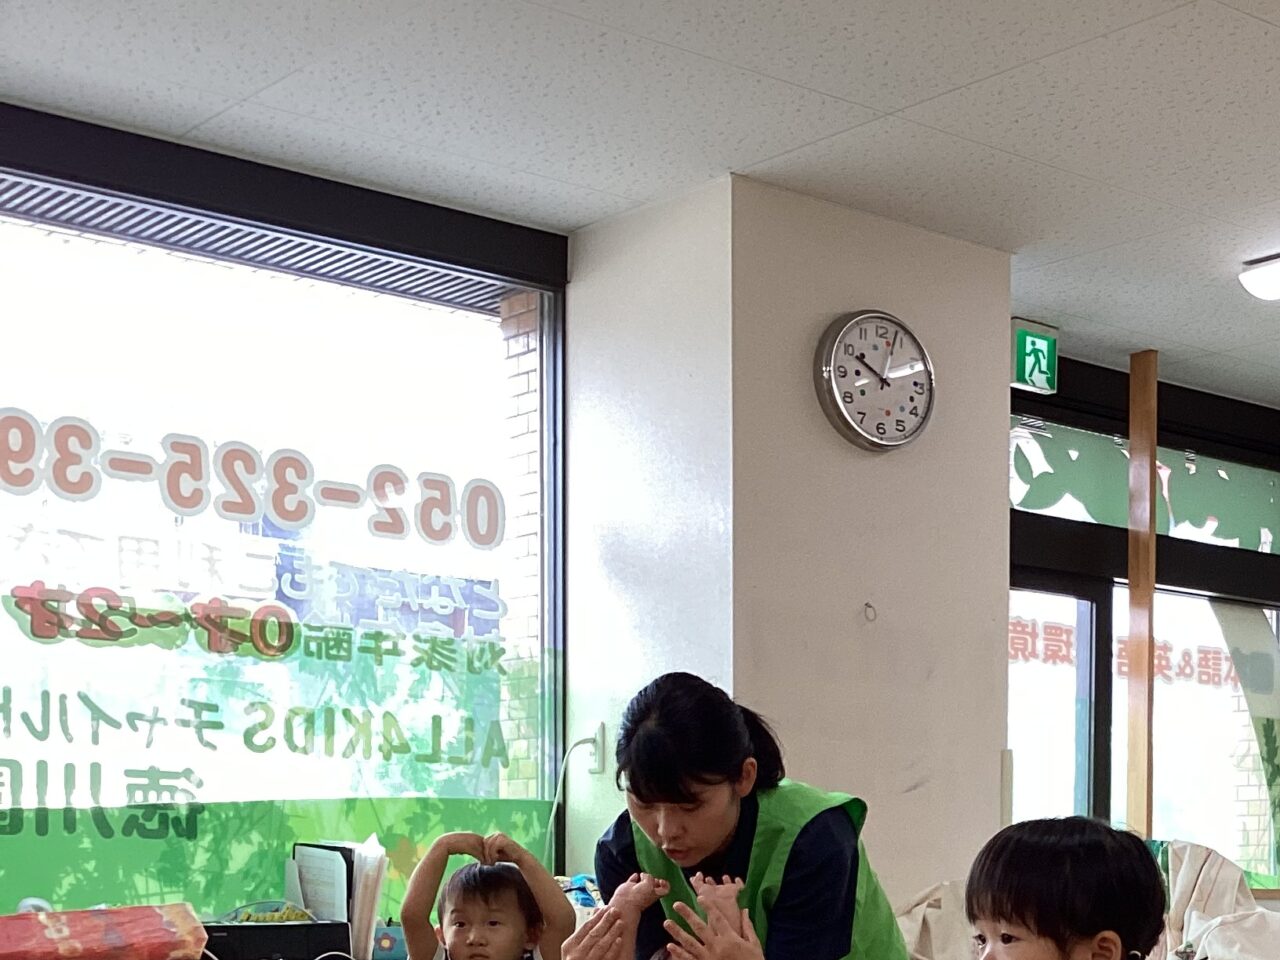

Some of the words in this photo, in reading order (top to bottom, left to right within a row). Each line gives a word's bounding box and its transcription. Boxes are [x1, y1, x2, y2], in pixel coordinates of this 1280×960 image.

[859, 327, 867, 341] 11
[875, 325, 888, 339] 12
[844, 343, 855, 356] 10
[837, 365, 848, 378] 9
[914, 383, 925, 395] 3
[842, 391, 854, 404] 8
[857, 412, 866, 424] 7
[909, 405, 919, 418] 4
[876, 422, 887, 435] 6
[895, 419, 906, 432] 5
